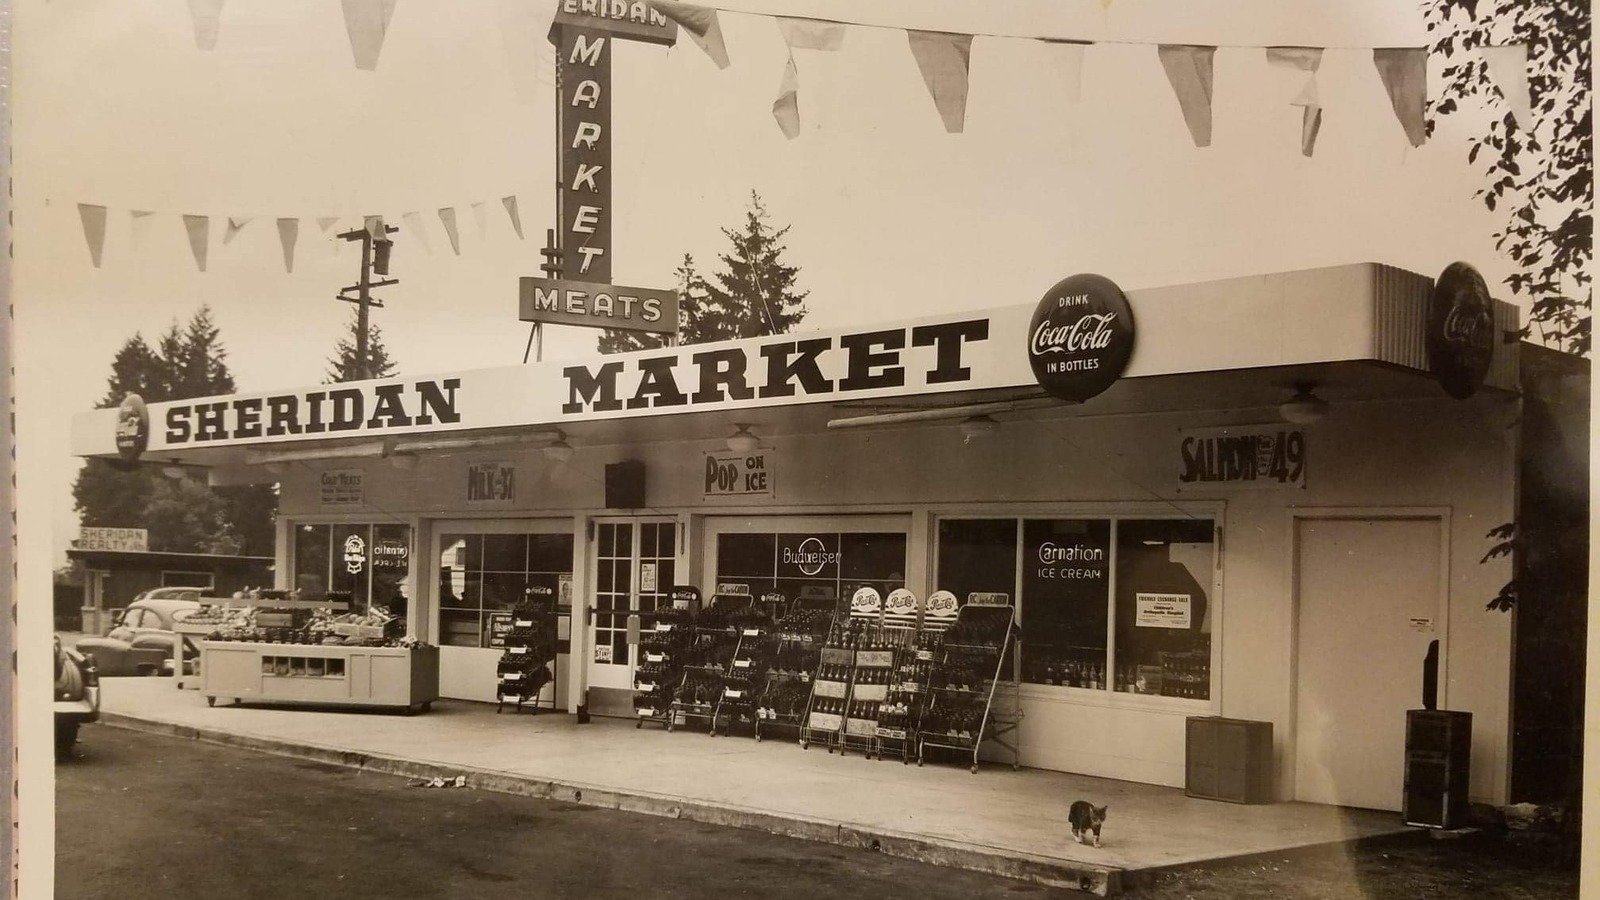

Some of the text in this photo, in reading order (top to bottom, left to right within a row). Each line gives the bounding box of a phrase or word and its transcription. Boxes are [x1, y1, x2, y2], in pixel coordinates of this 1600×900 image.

[569, 34, 605, 274] MARKET
[533, 287, 662, 322] MEATS
[1058, 294, 1088, 307] DRINK
[1031, 312, 1118, 356] Coca-Cola
[1047, 358, 1099, 373] IN BOTTLES
[165, 378, 461, 444] SHERIDAN
[562, 318, 990, 414] MARKET
[745, 455, 764, 469] ON
[1268, 430, 1304, 483] 49
[745, 472, 767, 491] ICE
[80, 528, 143, 540] SHERIDAN
[783, 547, 842, 564] Budweiser
[1038, 541, 1103, 565] Carnation
[1038, 568, 1101, 579] ICE CREAM
